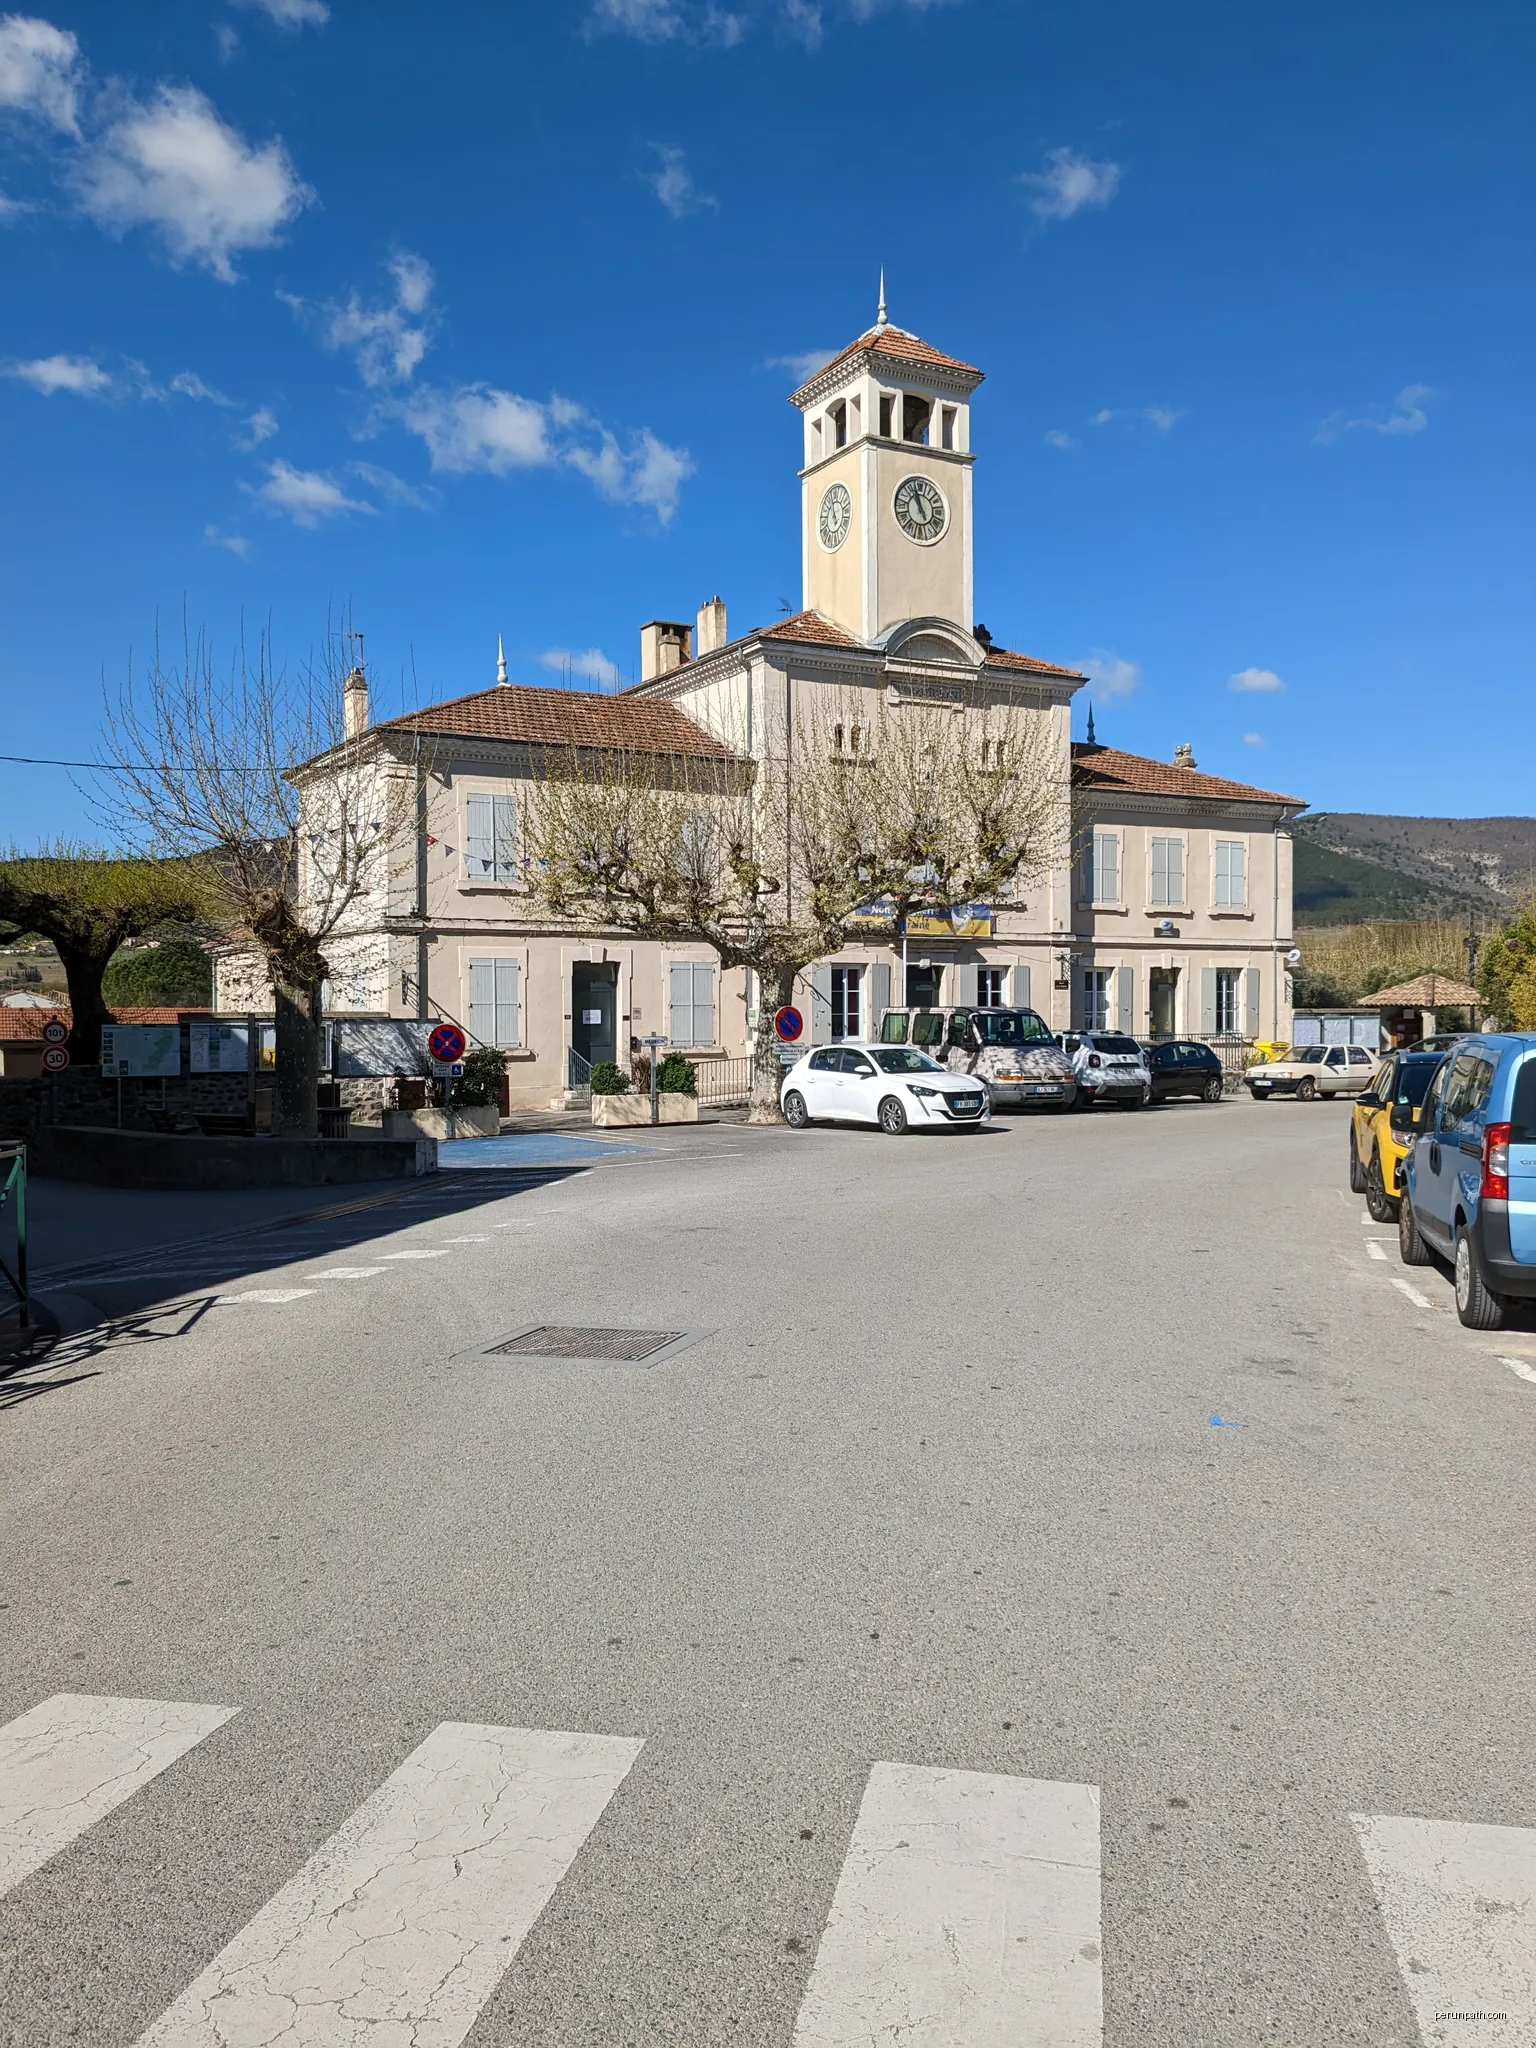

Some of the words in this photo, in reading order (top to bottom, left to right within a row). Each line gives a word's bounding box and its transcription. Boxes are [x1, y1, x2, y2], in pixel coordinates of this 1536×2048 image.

[870, 906, 891, 915] Non
[48, 1029, 62, 1037] 10t
[49, 1054, 63, 1063] 30
